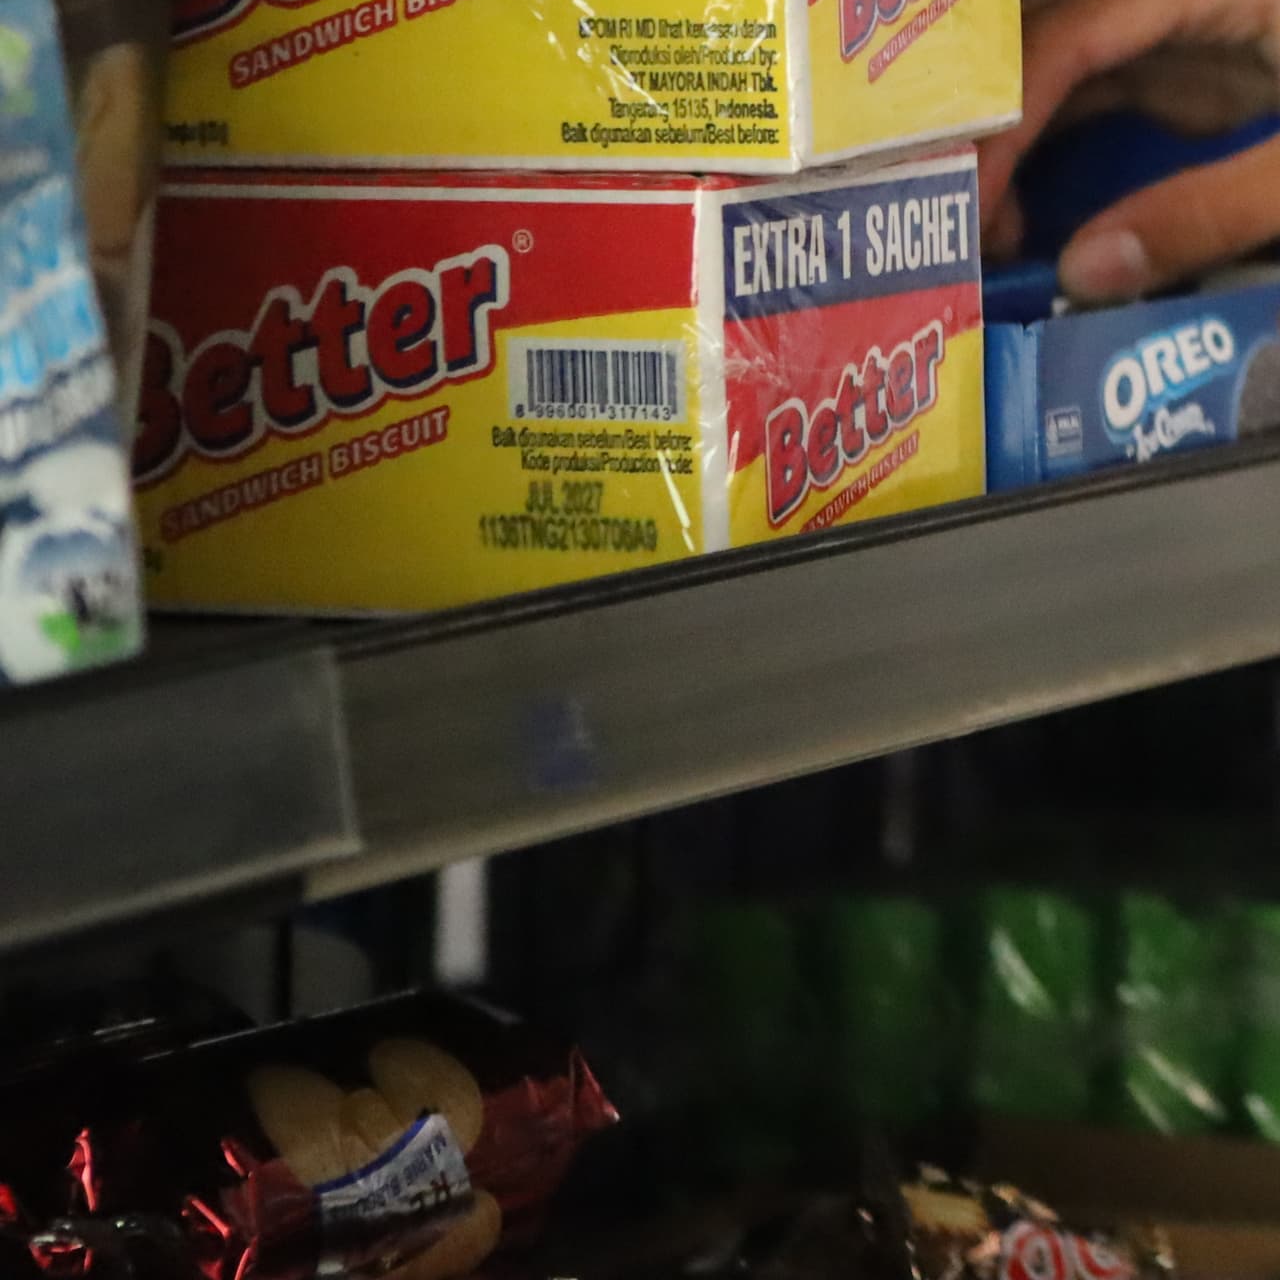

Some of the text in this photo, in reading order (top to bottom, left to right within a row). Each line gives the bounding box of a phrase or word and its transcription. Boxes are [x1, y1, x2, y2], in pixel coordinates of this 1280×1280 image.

[232, 0, 396, 84] SANDWICH
[651, 72, 704, 92] MAYORA
[707, 72, 747, 92] INDAH
[734, 191, 972, 297] EXTRA 1 SACHET
[134, 244, 511, 486] Better
[607, 405, 673, 421] 317143
[1103, 318, 1236, 431] OREO
[166, 410, 449, 535] SANDWICH BISCUIT
[765, 320, 943, 528] Better
